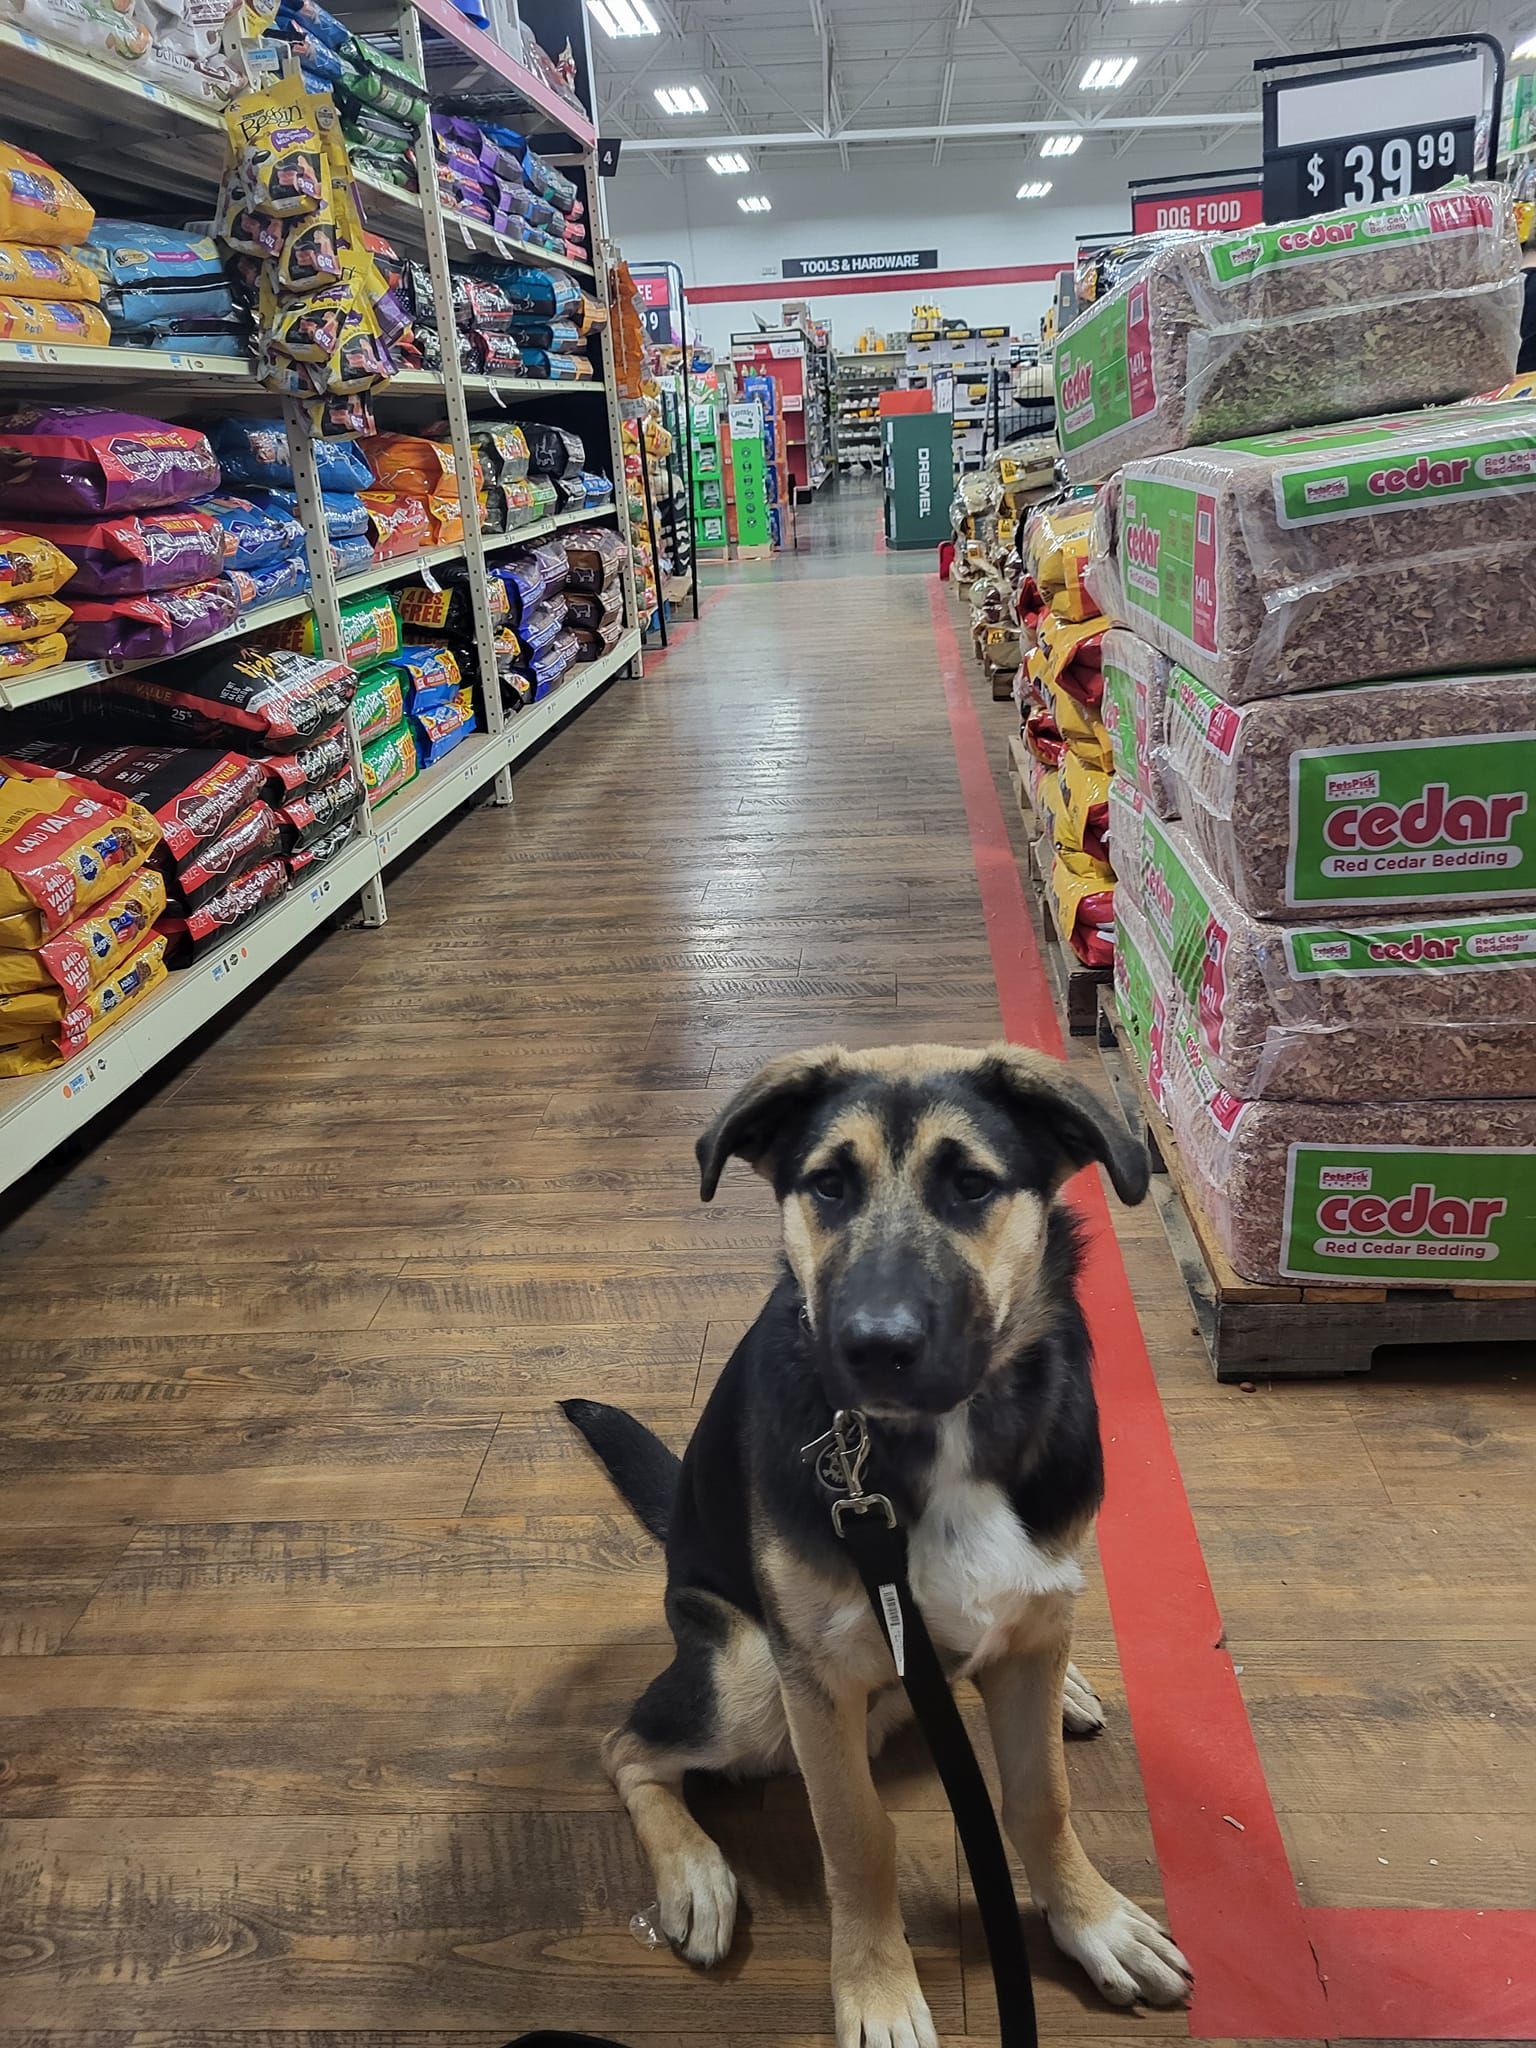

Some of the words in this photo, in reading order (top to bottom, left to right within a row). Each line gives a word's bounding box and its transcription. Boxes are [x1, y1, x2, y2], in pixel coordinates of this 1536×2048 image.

[602, 150, 613, 165] 4
[1344, 138, 1413, 208] 39
[1417, 131, 1455, 169] 99
[1157, 206, 1191, 230] DOG
[1197, 200, 1241, 225] FOOD
[1279, 222, 1356, 251] cedar
[800, 260, 839, 274] TOOLS
[841, 258, 850, 271] &
[852, 254, 920, 270] HARDWARE
[1062, 358, 1092, 413] cedar
[1508, 453, 1536, 463] Ceda
[918, 448, 931, 518] DREMEL
[1369, 458, 1469, 494] cedar
[1127, 515, 1160, 570] cedar
[401, 603, 443, 624] FREE
[170, 709, 193, 721] 25%
[1329, 777, 1375, 791] PetsPick
[1327, 787, 1523, 847] cedar
[14, 831, 49, 854] 44lb
[171, 830, 189, 850] SIZE
[1334, 858, 1368, 872] Red
[1374, 855, 1425, 871] Cedar
[1432, 851, 1508, 867] Bedding
[45, 874, 66, 892] 44lb
[181, 866, 200, 884] SIZE
[47, 879, 76, 907] VALUE
[1369, 935, 1461, 961] cedar
[1476, 937, 1496, 946] Red
[1498, 934, 1529, 944] Cedar
[1476, 943, 1519, 954] Bedding
[61, 951, 81, 972] 44lb
[64, 957, 90, 986] VALUE
[66, 1008, 87, 1026] 44lb
[1322, 1171, 1368, 1182] PetsPick
[1320, 1187, 1503, 1234] cedar
[1325, 1241, 1357, 1254] Red
[1362, 1242, 1411, 1255] Cedar
[1416, 1244, 1486, 1258] Bedding
